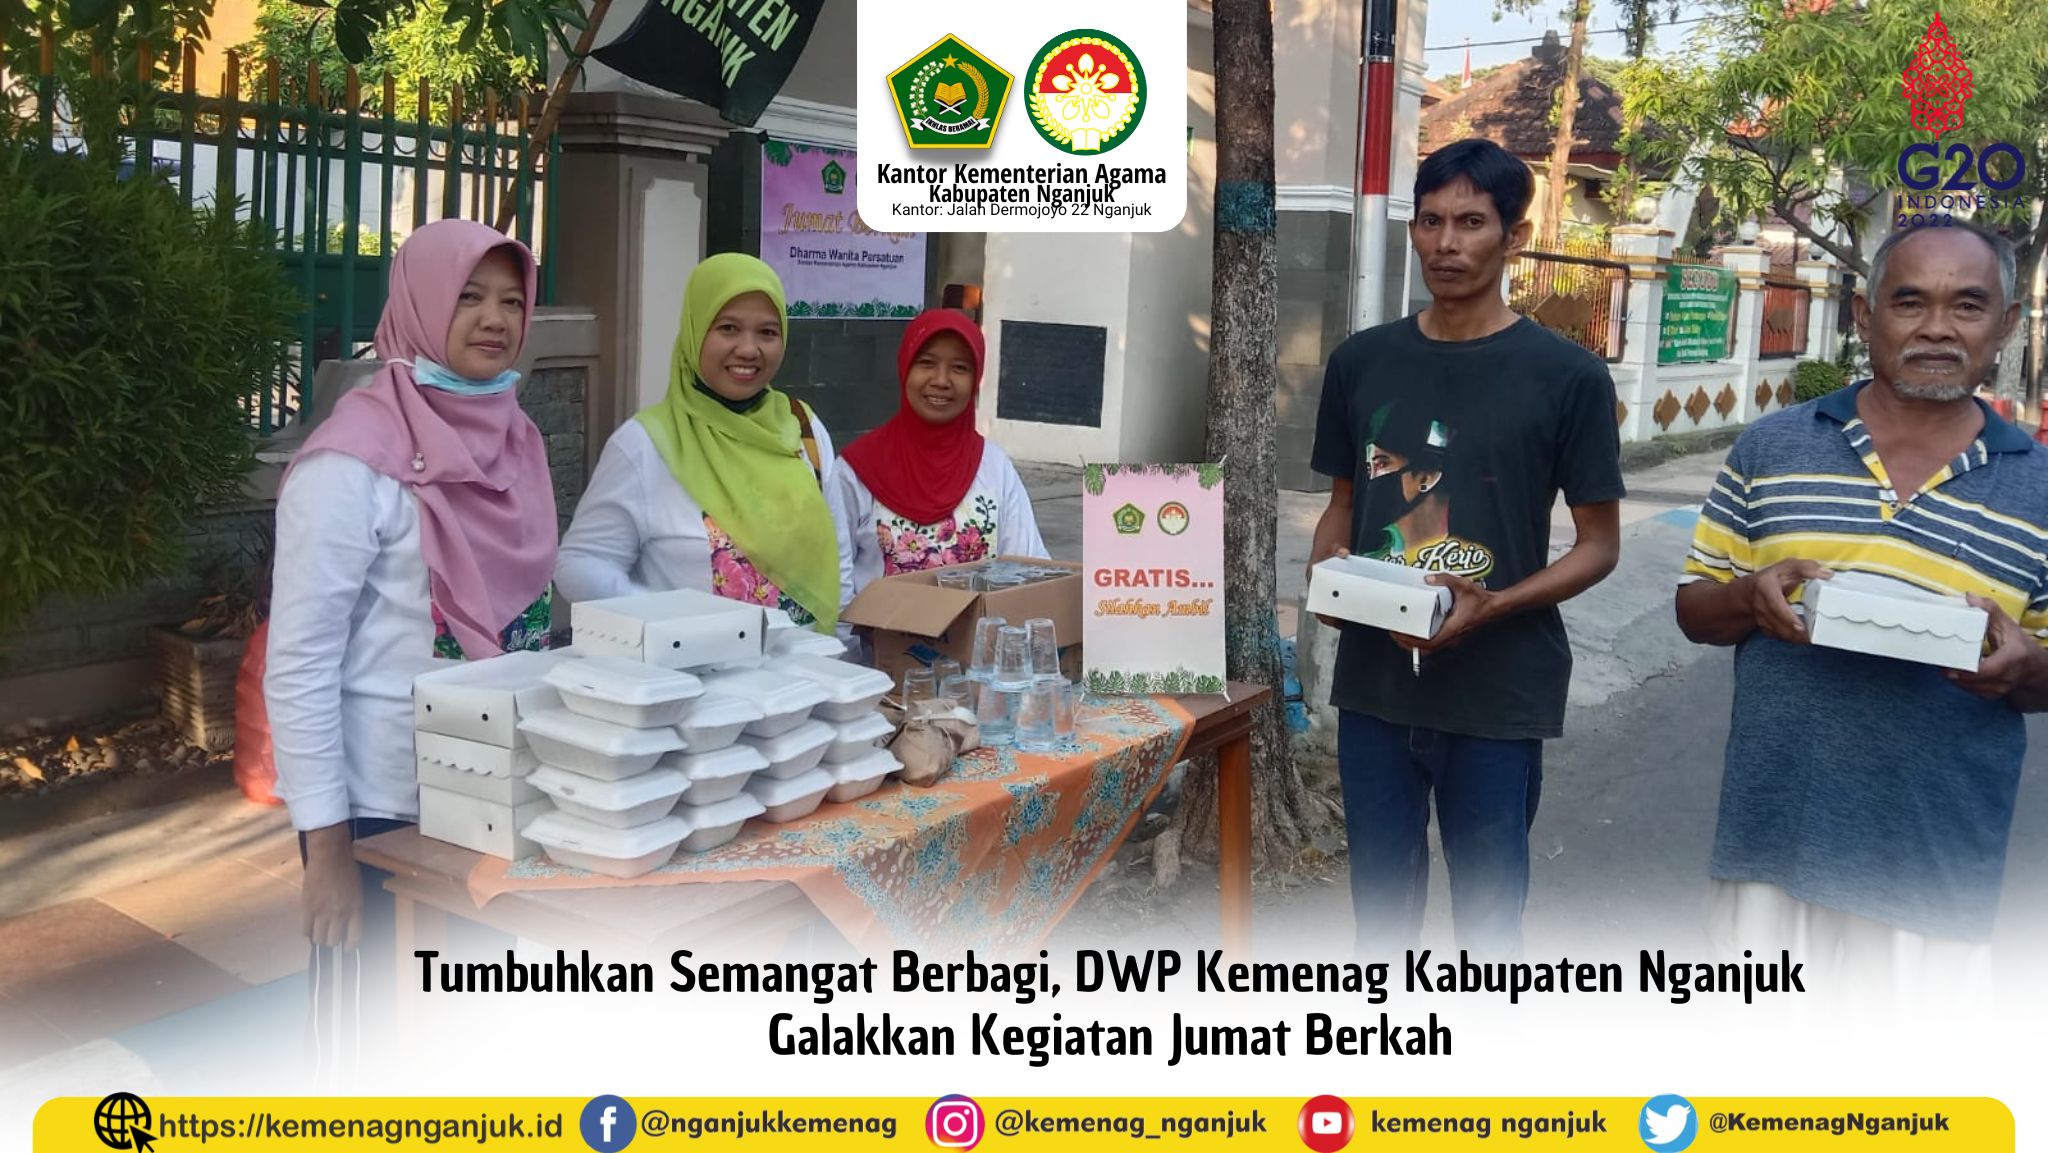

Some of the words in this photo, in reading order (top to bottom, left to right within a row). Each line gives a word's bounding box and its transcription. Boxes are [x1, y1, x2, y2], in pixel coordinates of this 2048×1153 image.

[789, 246, 827, 260] Dharma
[828, 248, 860, 261] Wanita
[861, 250, 905, 264] Persatuan
[1094, 568, 1214, 588] GRATIS...
[1161, 598, 1214, 618] Ambil
